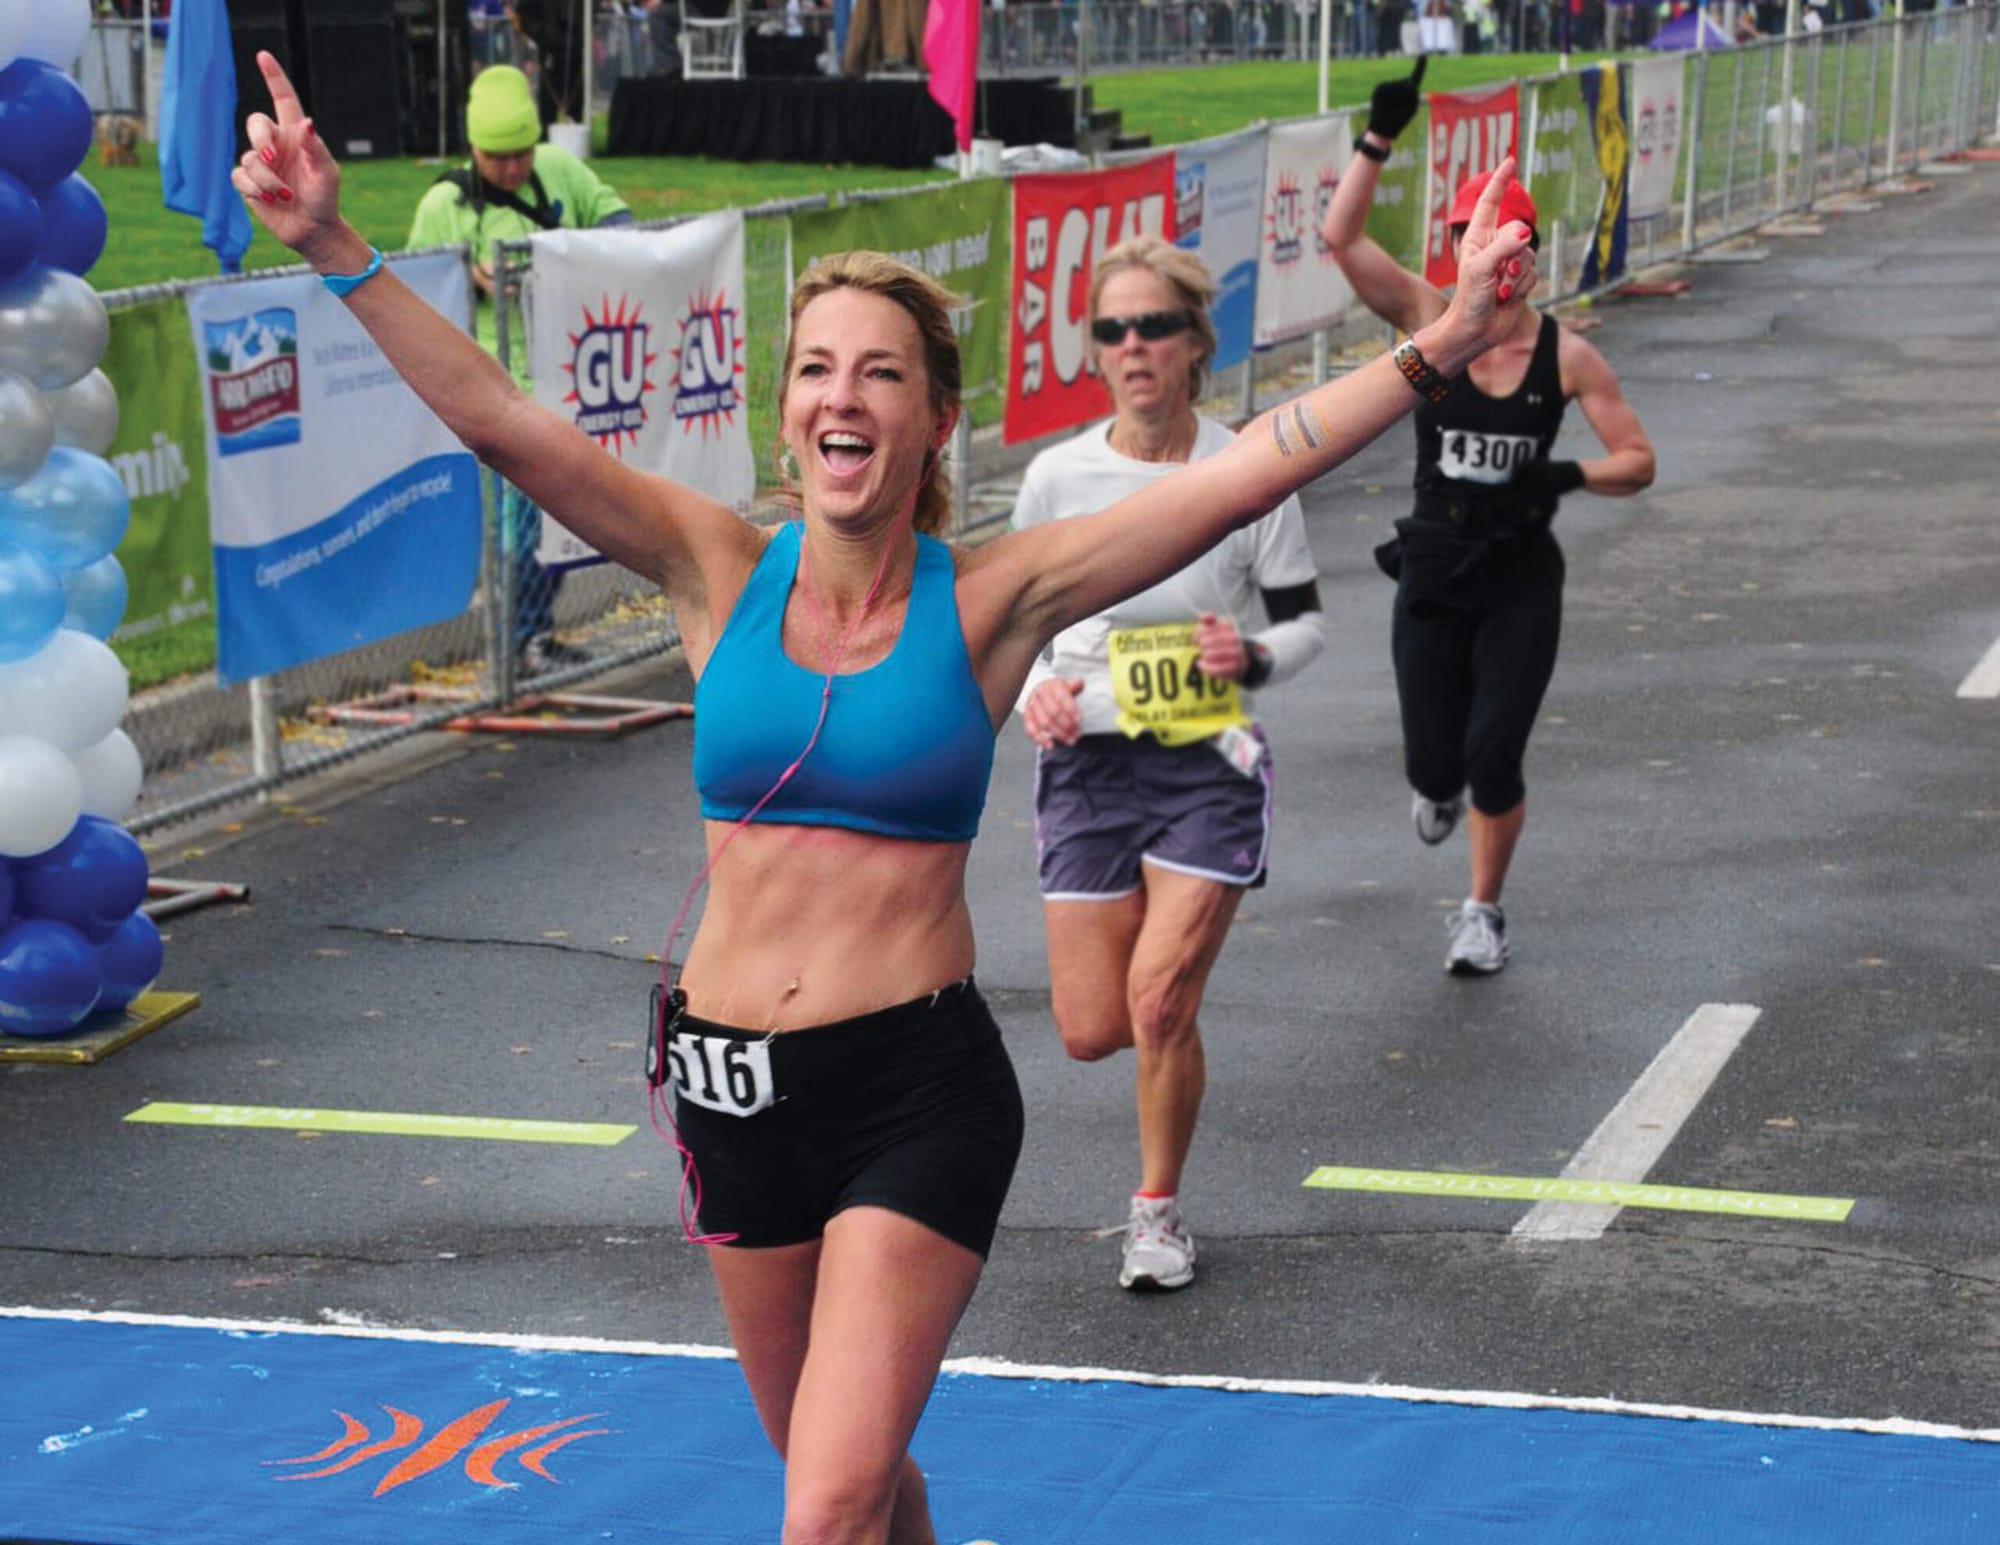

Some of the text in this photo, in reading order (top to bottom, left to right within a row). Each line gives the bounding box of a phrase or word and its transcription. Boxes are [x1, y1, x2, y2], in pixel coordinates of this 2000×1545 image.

[1017, 216, 1048, 397] BAR
[576, 328, 646, 408] GU
[680, 314, 735, 390] GU
[1450, 433, 1531, 472] 4300
